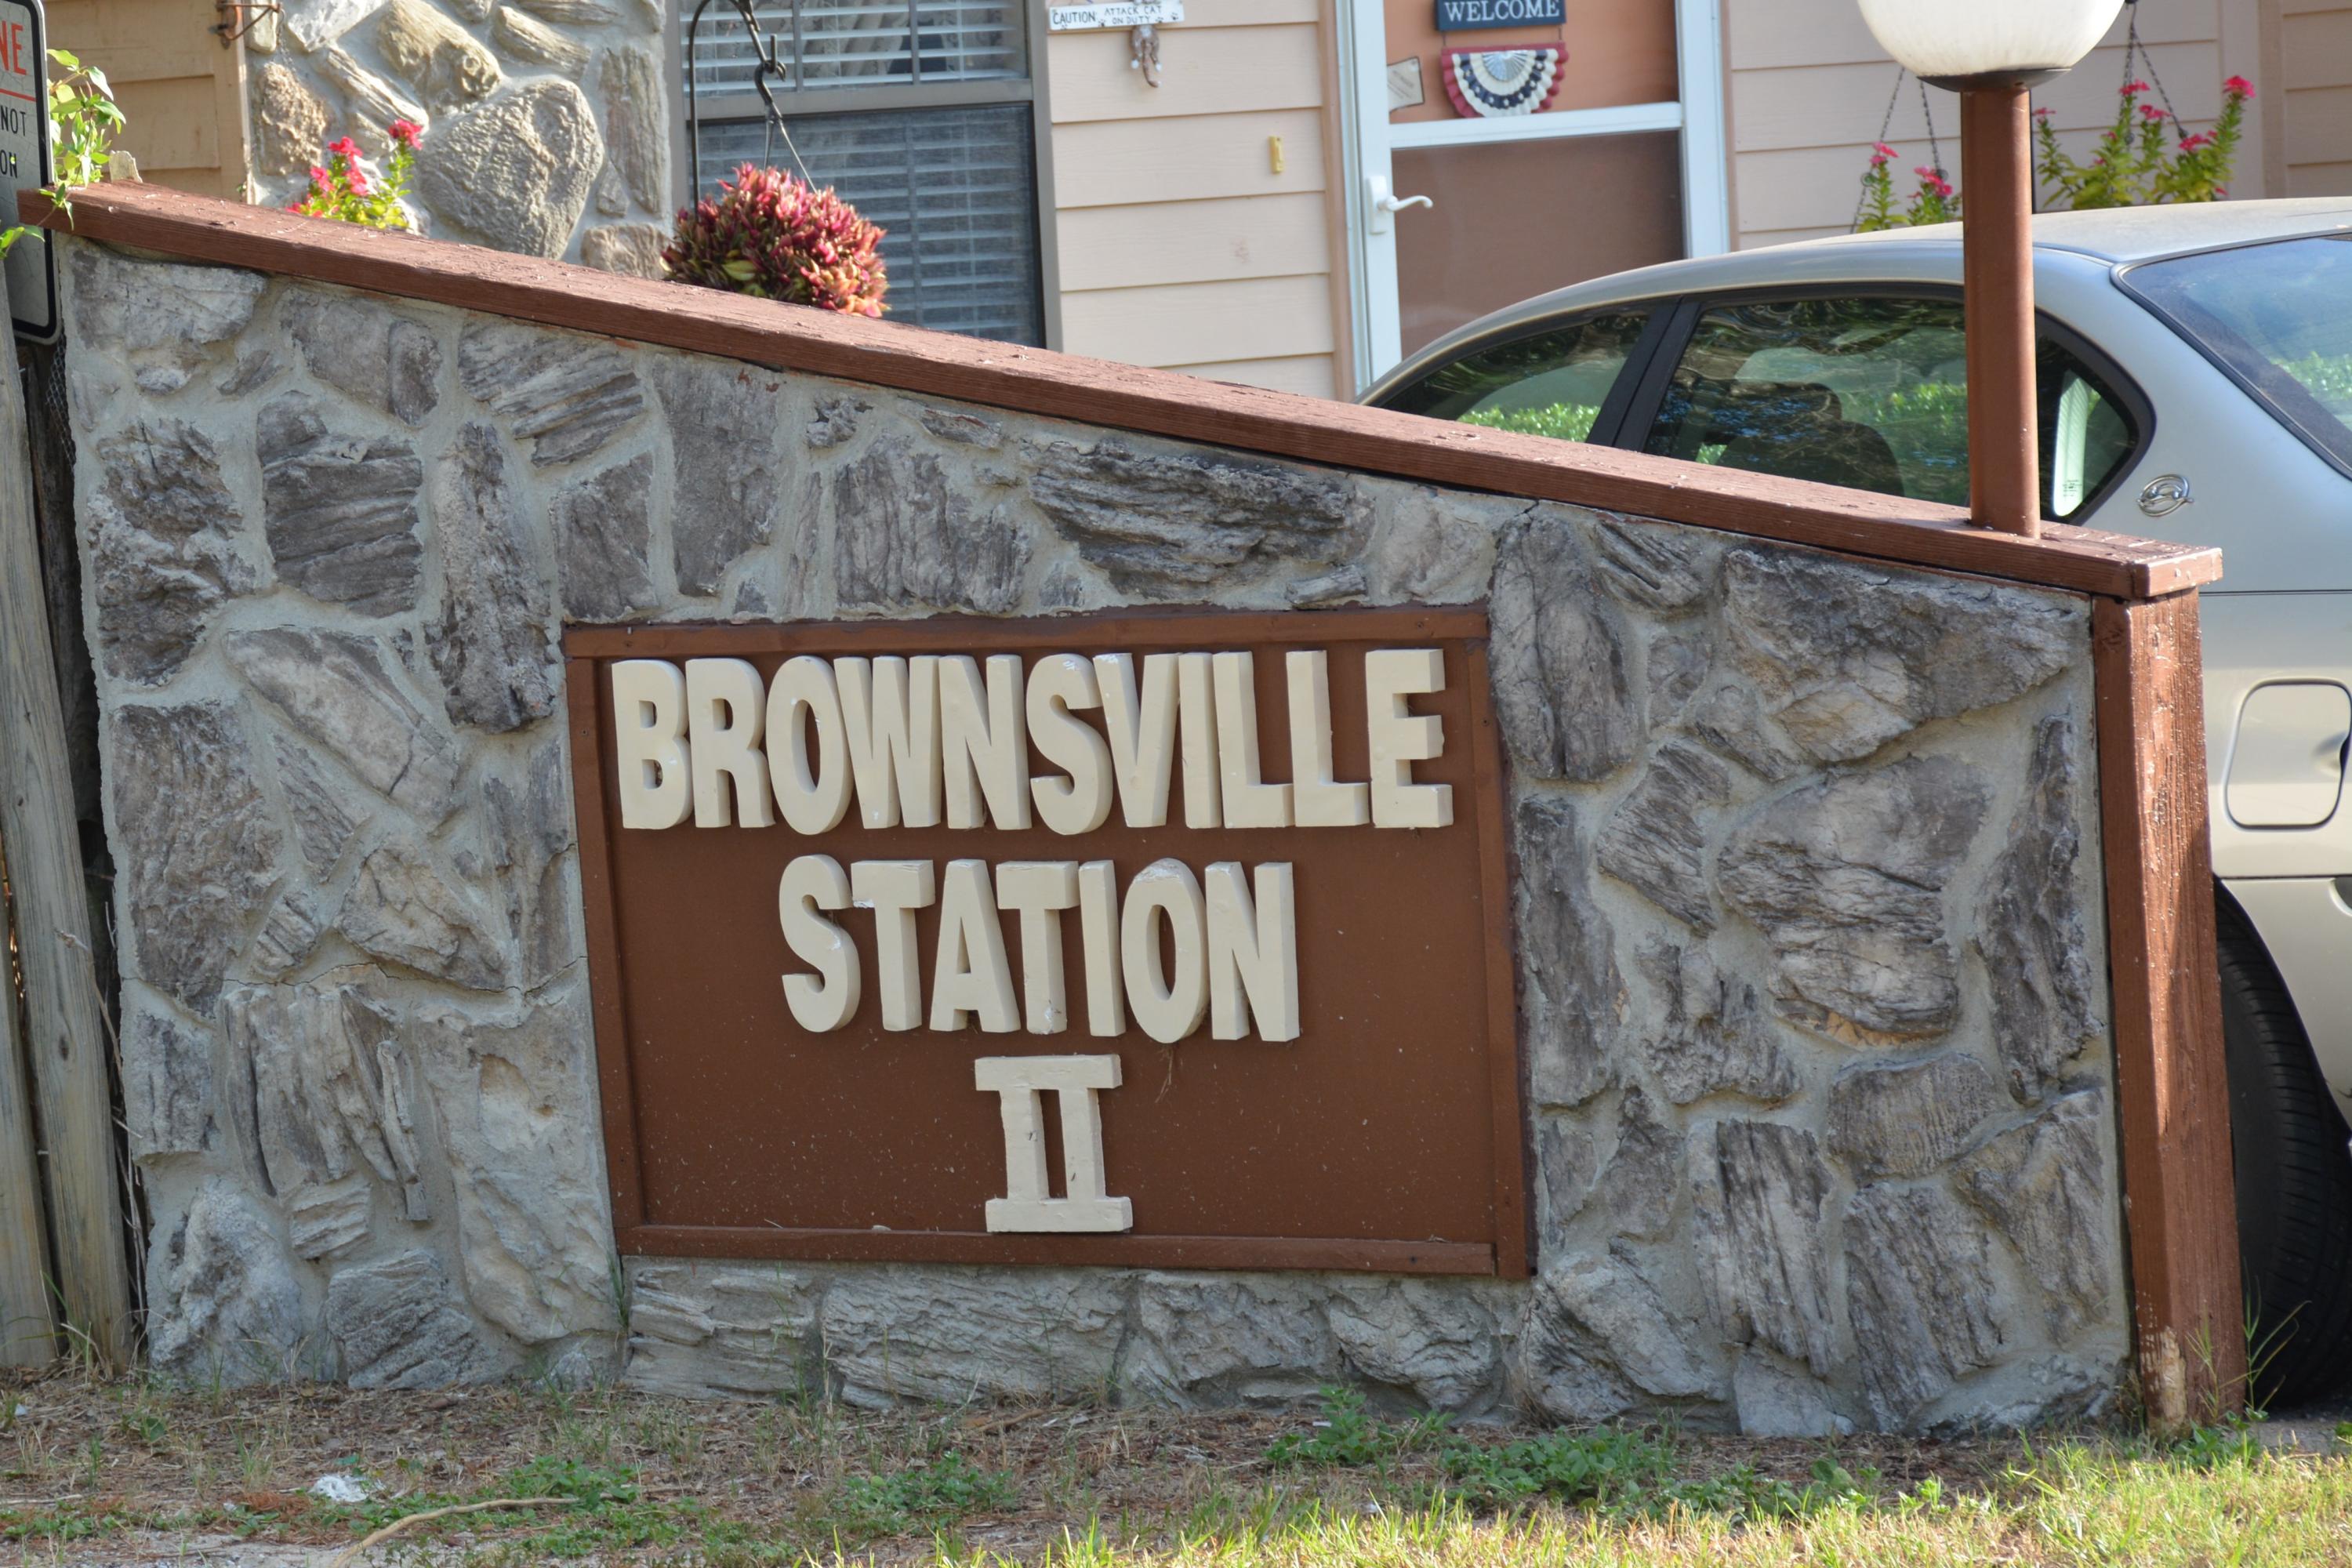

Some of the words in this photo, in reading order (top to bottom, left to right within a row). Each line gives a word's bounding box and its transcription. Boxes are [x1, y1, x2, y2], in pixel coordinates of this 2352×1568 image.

[1105, 6, 1138, 16] ATTACK
[1145, 5, 1162, 14] CAT
[1444, 0, 1560, 22] WELCOME
[0, 105, 26, 136] NOT
[612, 648, 1454, 835] BROWNSVILLE
[779, 854, 1299, 1044] STATION
[975, 1053, 1133, 1232] II
